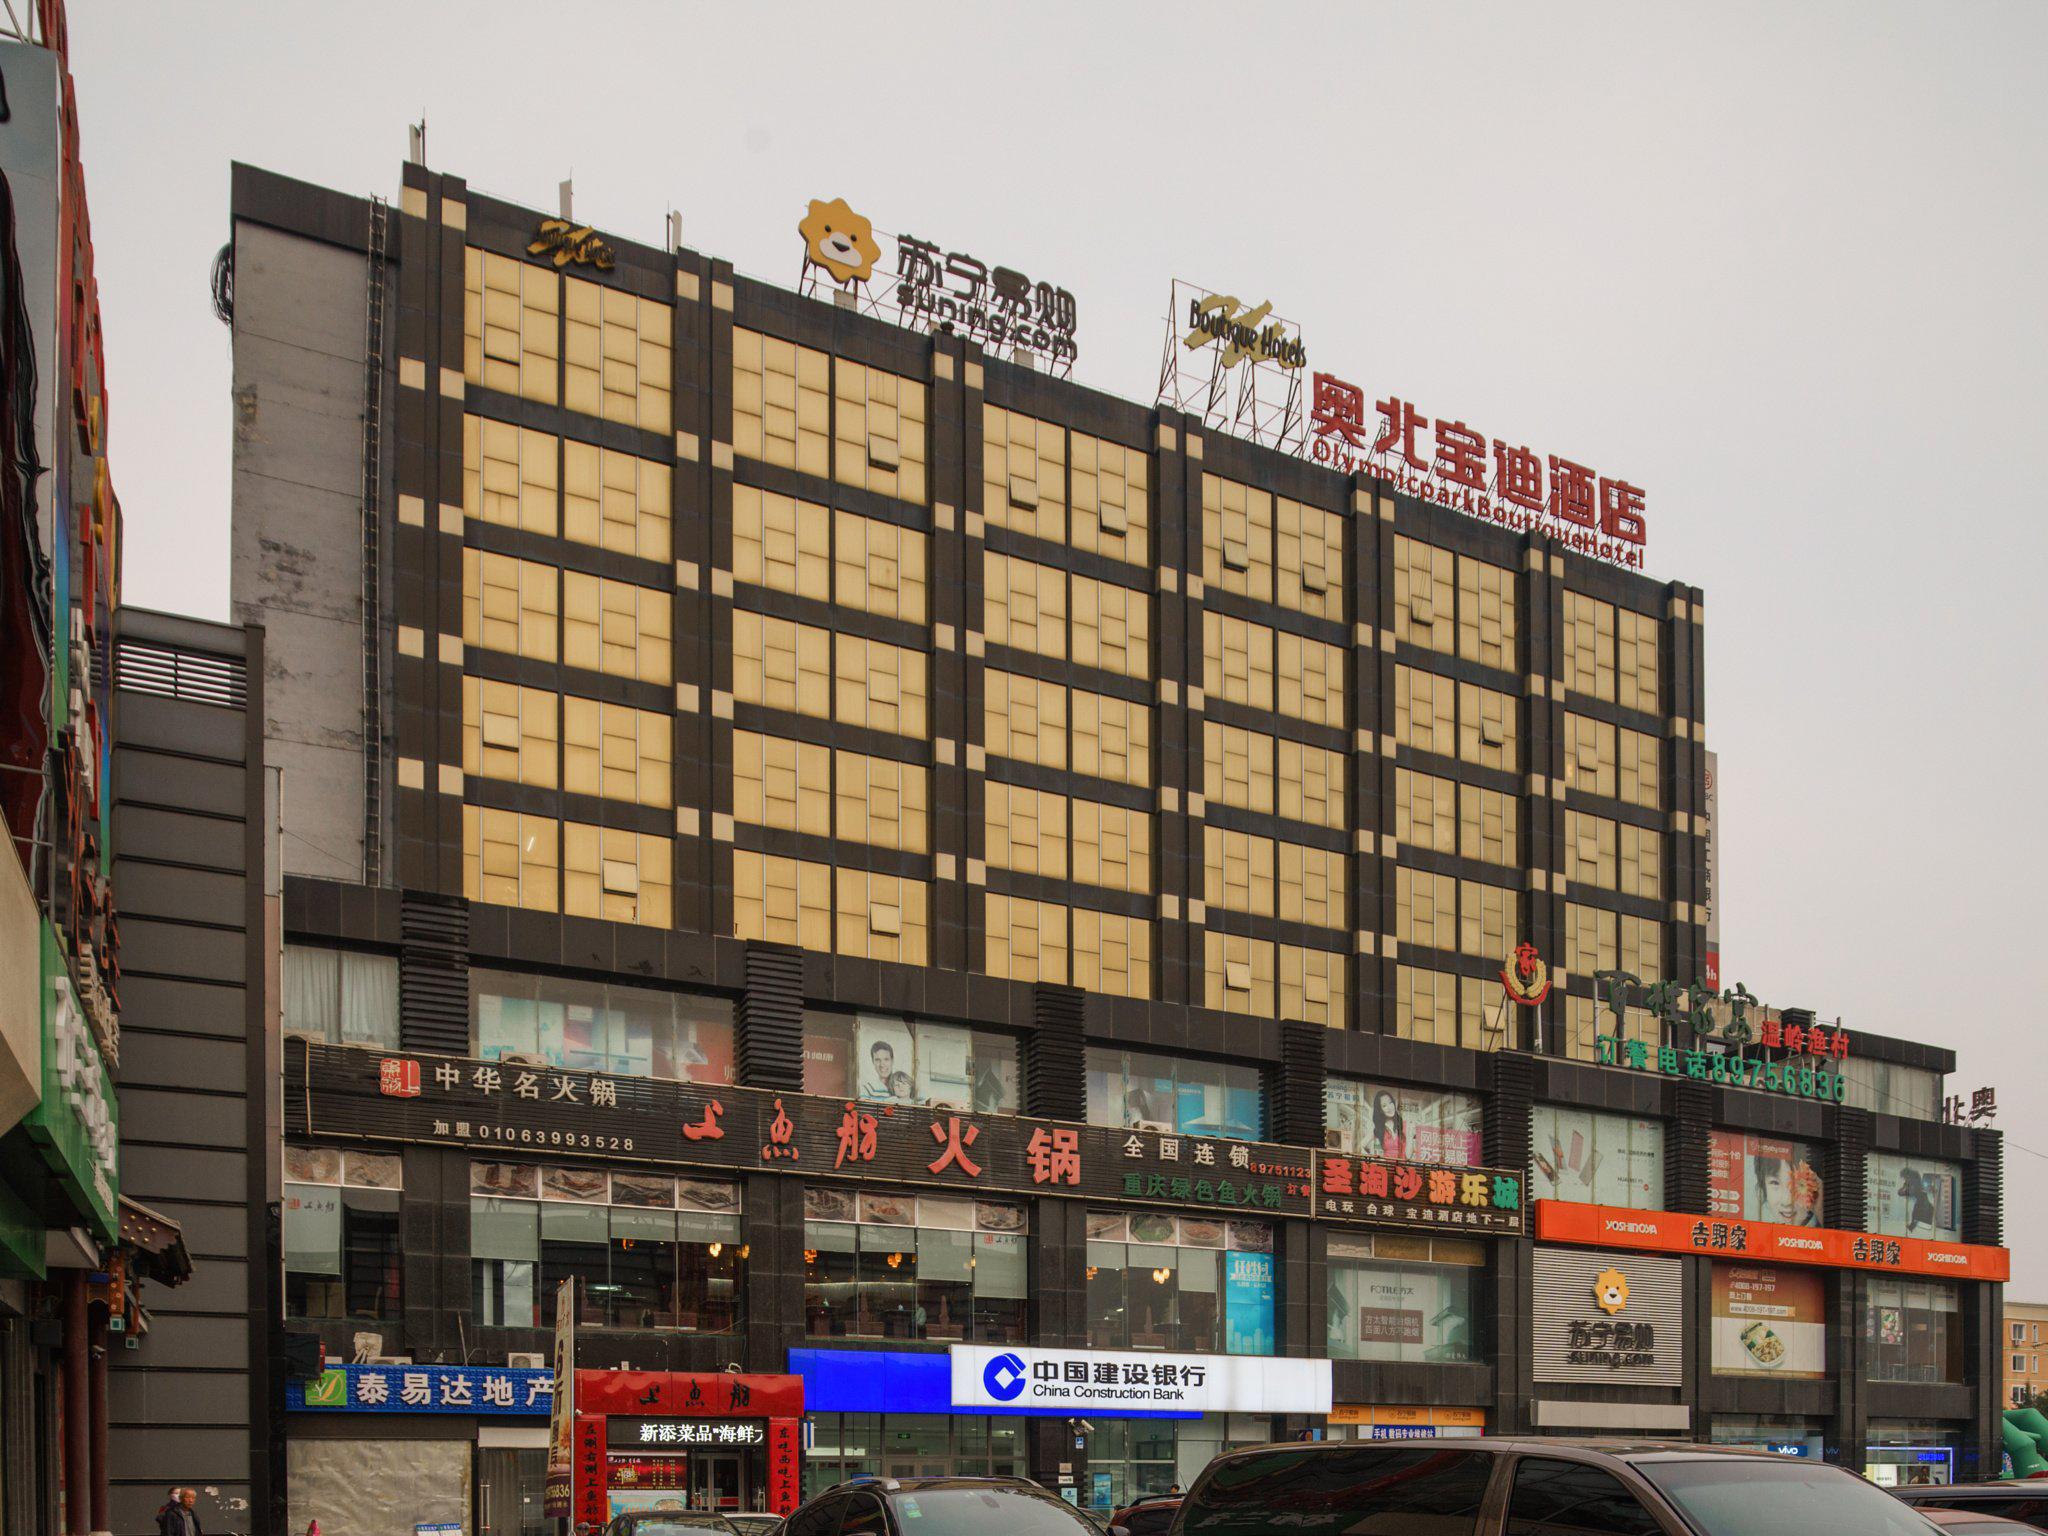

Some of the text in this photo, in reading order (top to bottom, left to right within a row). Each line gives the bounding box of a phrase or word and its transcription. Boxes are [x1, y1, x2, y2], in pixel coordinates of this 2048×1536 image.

[897, 234, 1077, 336] 苏宁易购
[1189, 299, 1307, 368] Boutique Hotels
[1311, 371, 1646, 546] 奥北宝迪酒店
[1761, 1020, 1850, 1060] 温岭渔村
[435, 1063, 616, 1107] 中华名火锅
[1123, 1135, 1250, 1169] 全国连锁
[1420, 1147, 1468, 1165] 苏宁易购
[1123, 1172, 1282, 1208] 重庆绿色鱼火锅
[1322, 1158, 1518, 1209] 圣淘沙游乐城
[1325, 1200, 1354, 1213] 电玩
[1405, 1208, 1519, 1227] 宝迪酒店地下一层
[1605, 1219, 1657, 1235] YOSHINOYA
[1778, 1236, 1824, 1251] YOSHINOYA
[1927, 1252, 1968, 1265] YOSHINOYA
[1566, 1319, 1654, 1350] 苏宁易购
[1033, 1360, 1206, 1387] 中国建设银行
[356, 1373, 555, 1408] 泰易达地产
[1033, 1384, 1184, 1400] China Construction Bank
[1777, 1445, 1799, 1455] vivo
